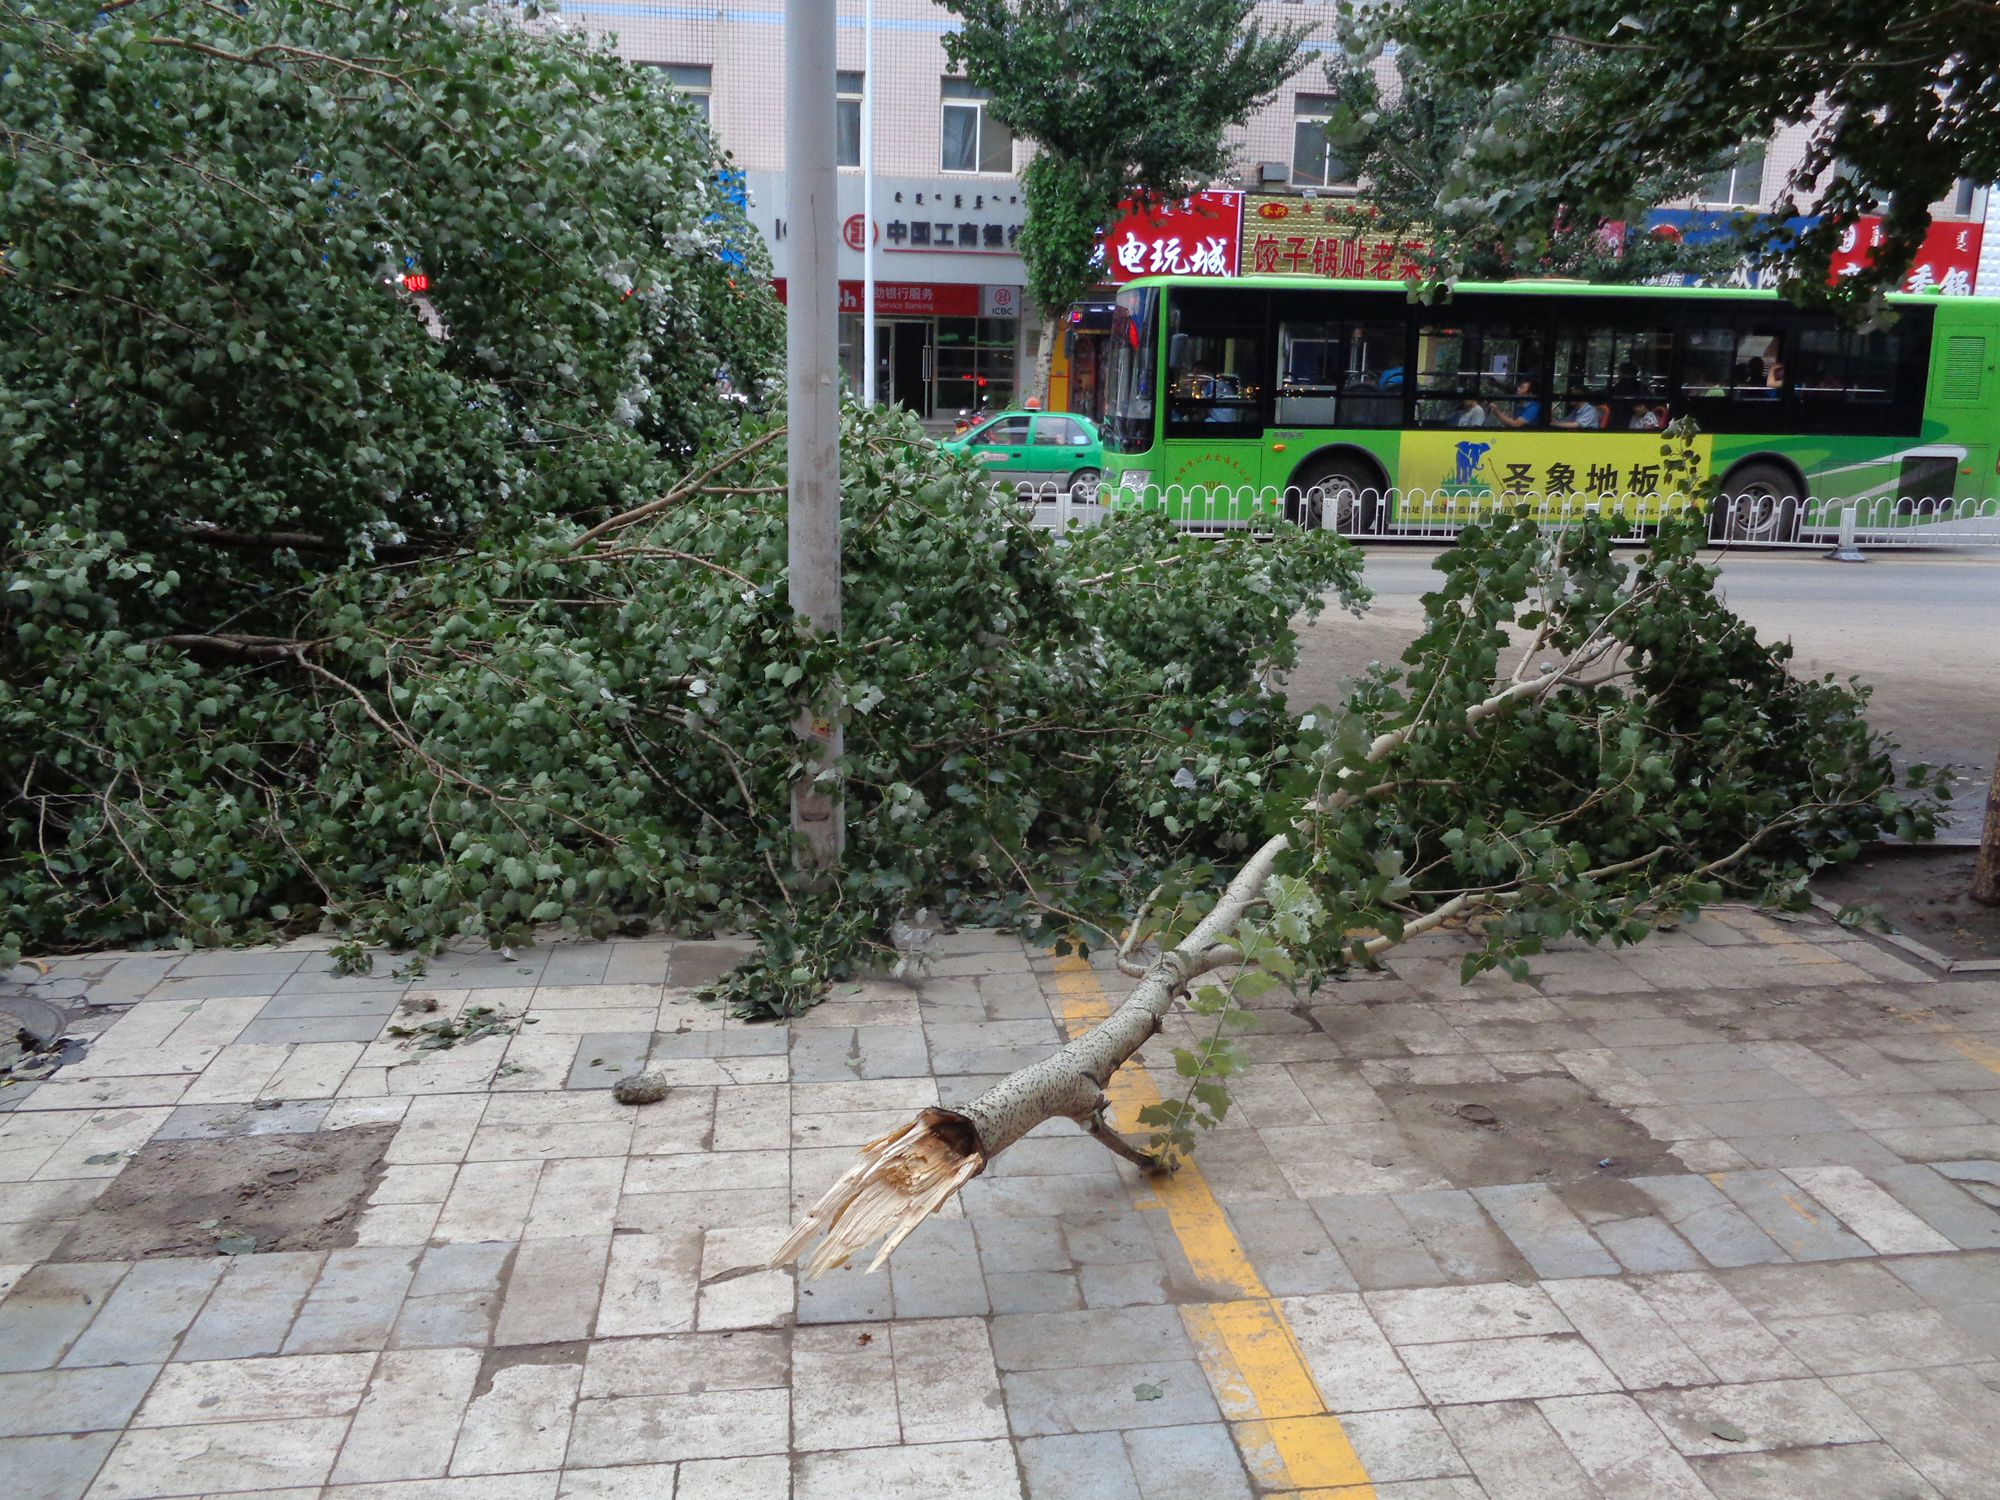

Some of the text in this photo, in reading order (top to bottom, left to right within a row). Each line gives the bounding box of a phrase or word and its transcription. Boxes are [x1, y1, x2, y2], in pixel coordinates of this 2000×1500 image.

[992, 307, 1013, 315] ICBC
[1503, 462, 1660, 498] 圣象地板
